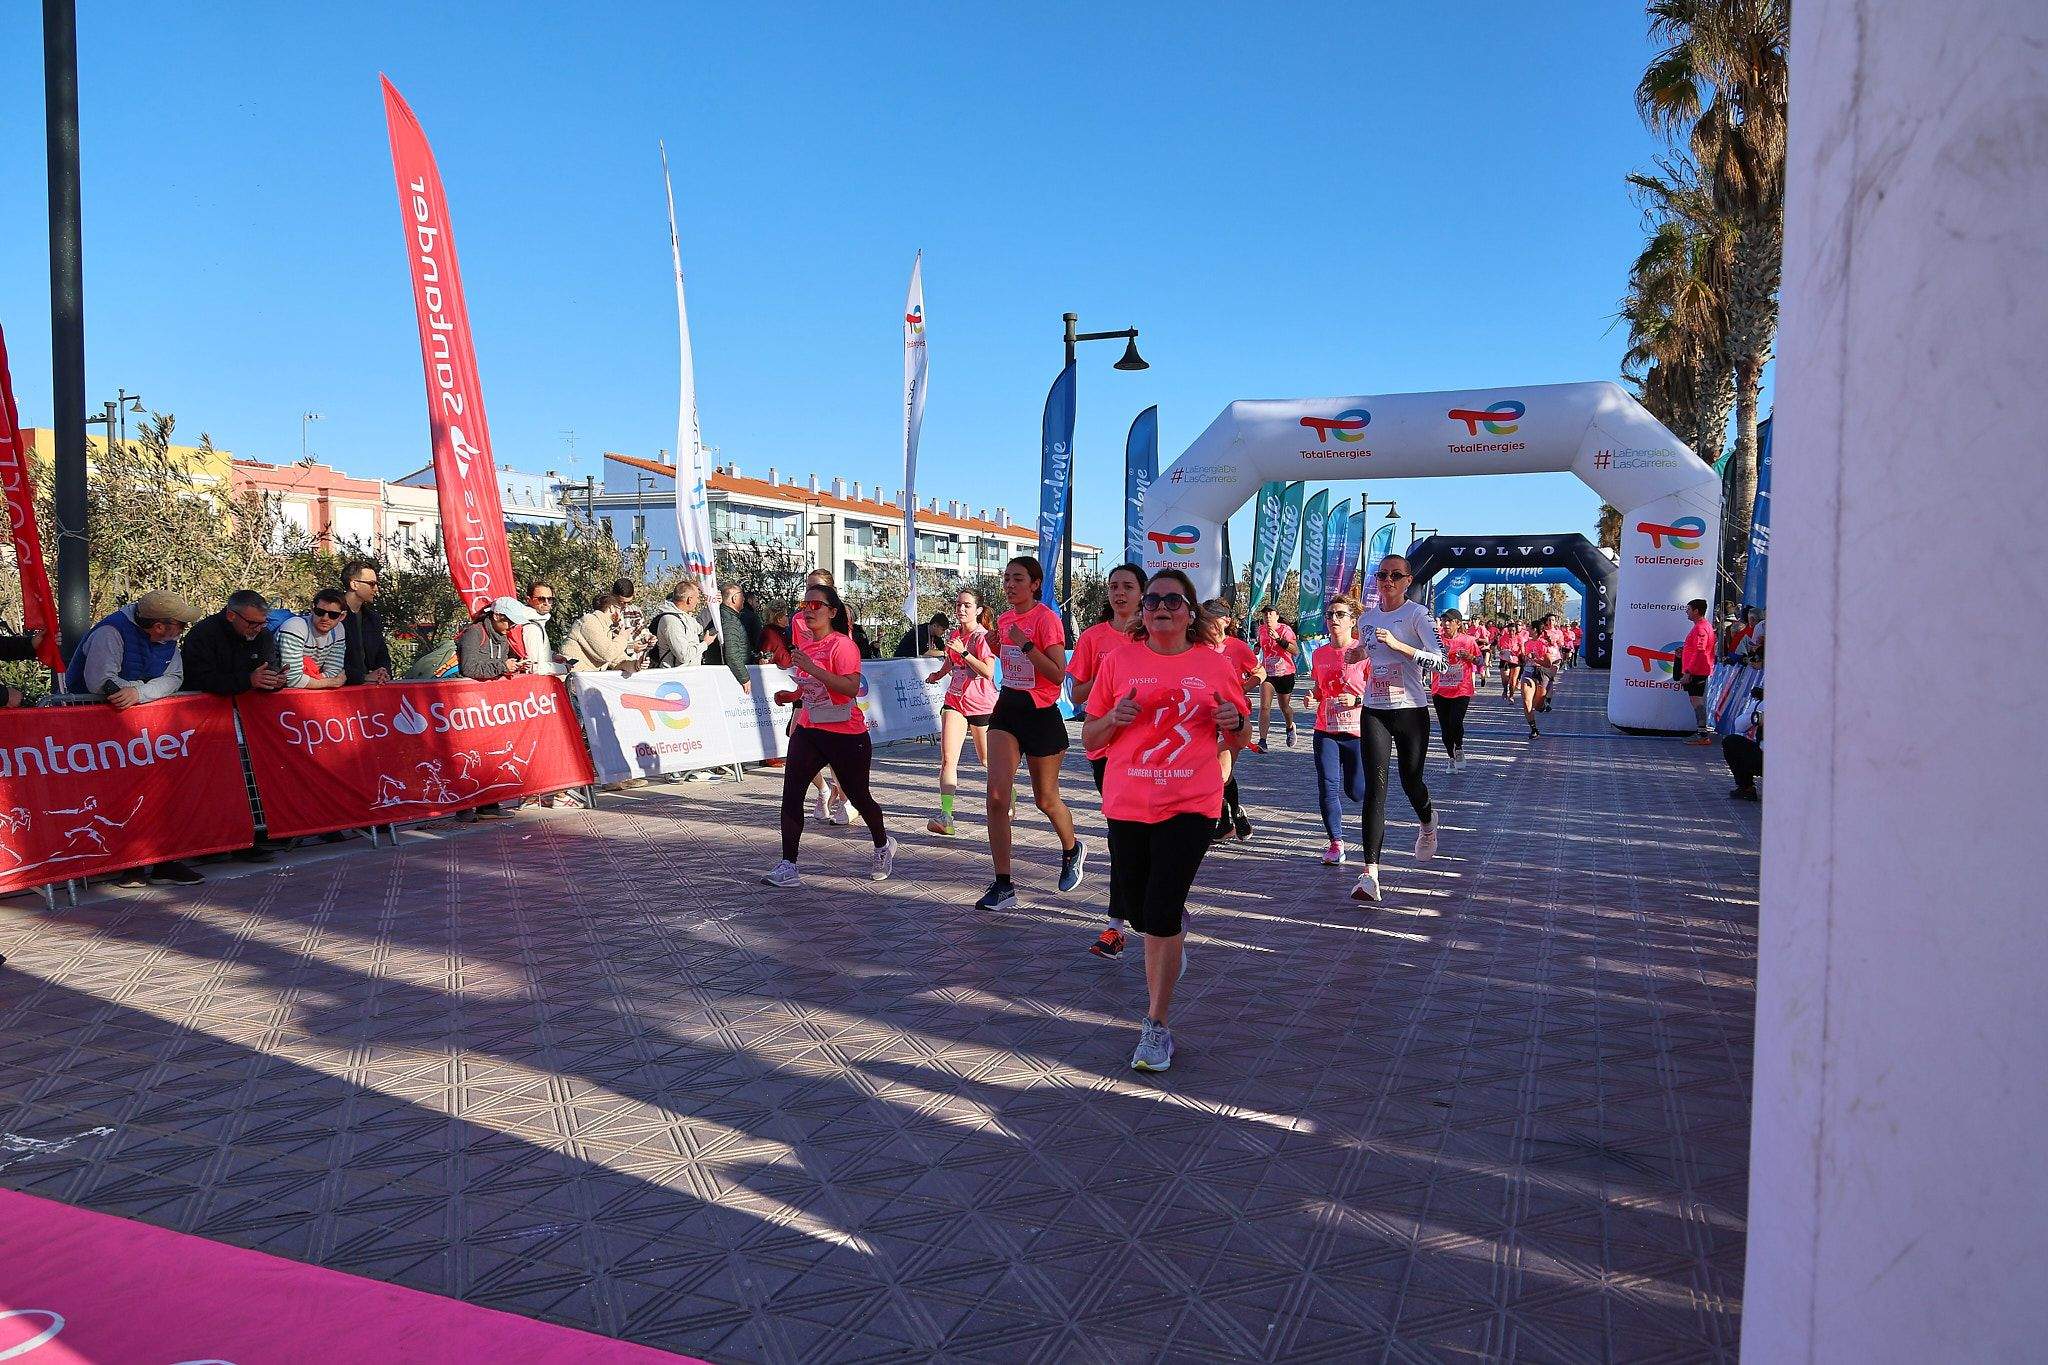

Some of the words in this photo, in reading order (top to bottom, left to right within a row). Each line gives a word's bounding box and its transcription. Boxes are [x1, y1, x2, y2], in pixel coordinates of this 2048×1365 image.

[1448, 441, 1525, 453] TotalEnergies
[1300, 449, 1372, 460] TotalEnergies
[1450, 546, 1555, 556] VOLVO
[1635, 555, 1704, 567] TotalEnergies
[1598, 585, 1607, 658] VOLVO
[279, 711, 389, 754] Sports
[431, 691, 557, 733] Santander
[632, 739, 703, 758] TotalEnergies
